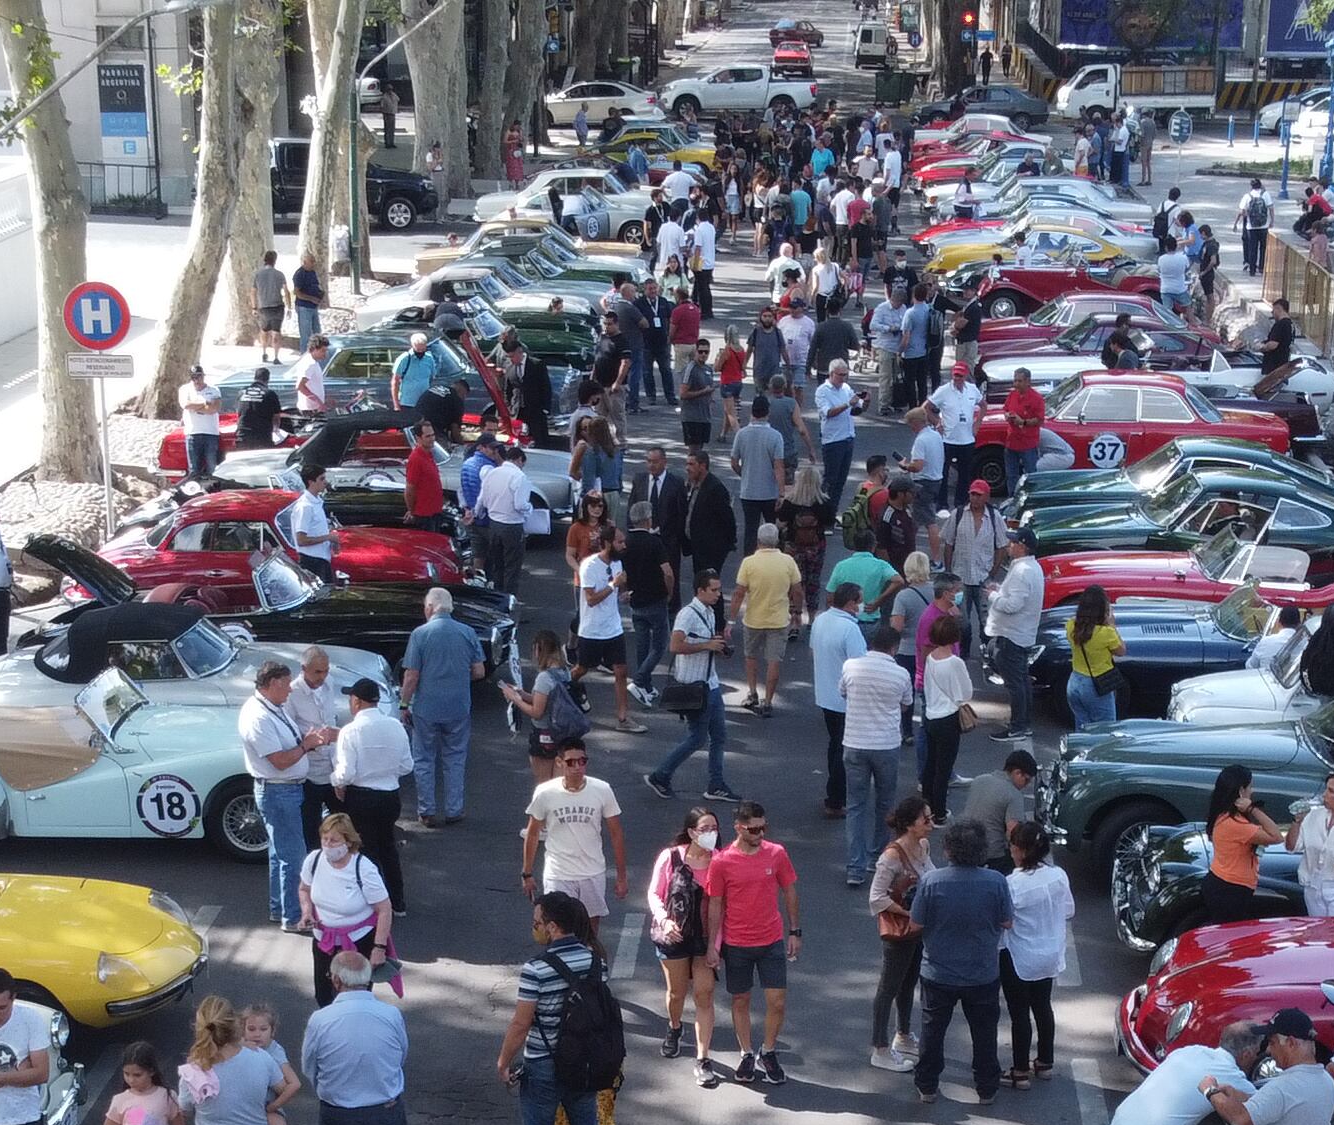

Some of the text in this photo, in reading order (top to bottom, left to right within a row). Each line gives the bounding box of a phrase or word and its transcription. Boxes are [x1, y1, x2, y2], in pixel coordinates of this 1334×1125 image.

[100, 69, 139, 77] PARRILLA
[81, 298, 112, 334] H
[1094, 442, 1121, 461] 37
[150, 792, 187, 820] 18
[553, 806, 595, 817] STRANGE
[558, 815, 591, 824] WORLD
